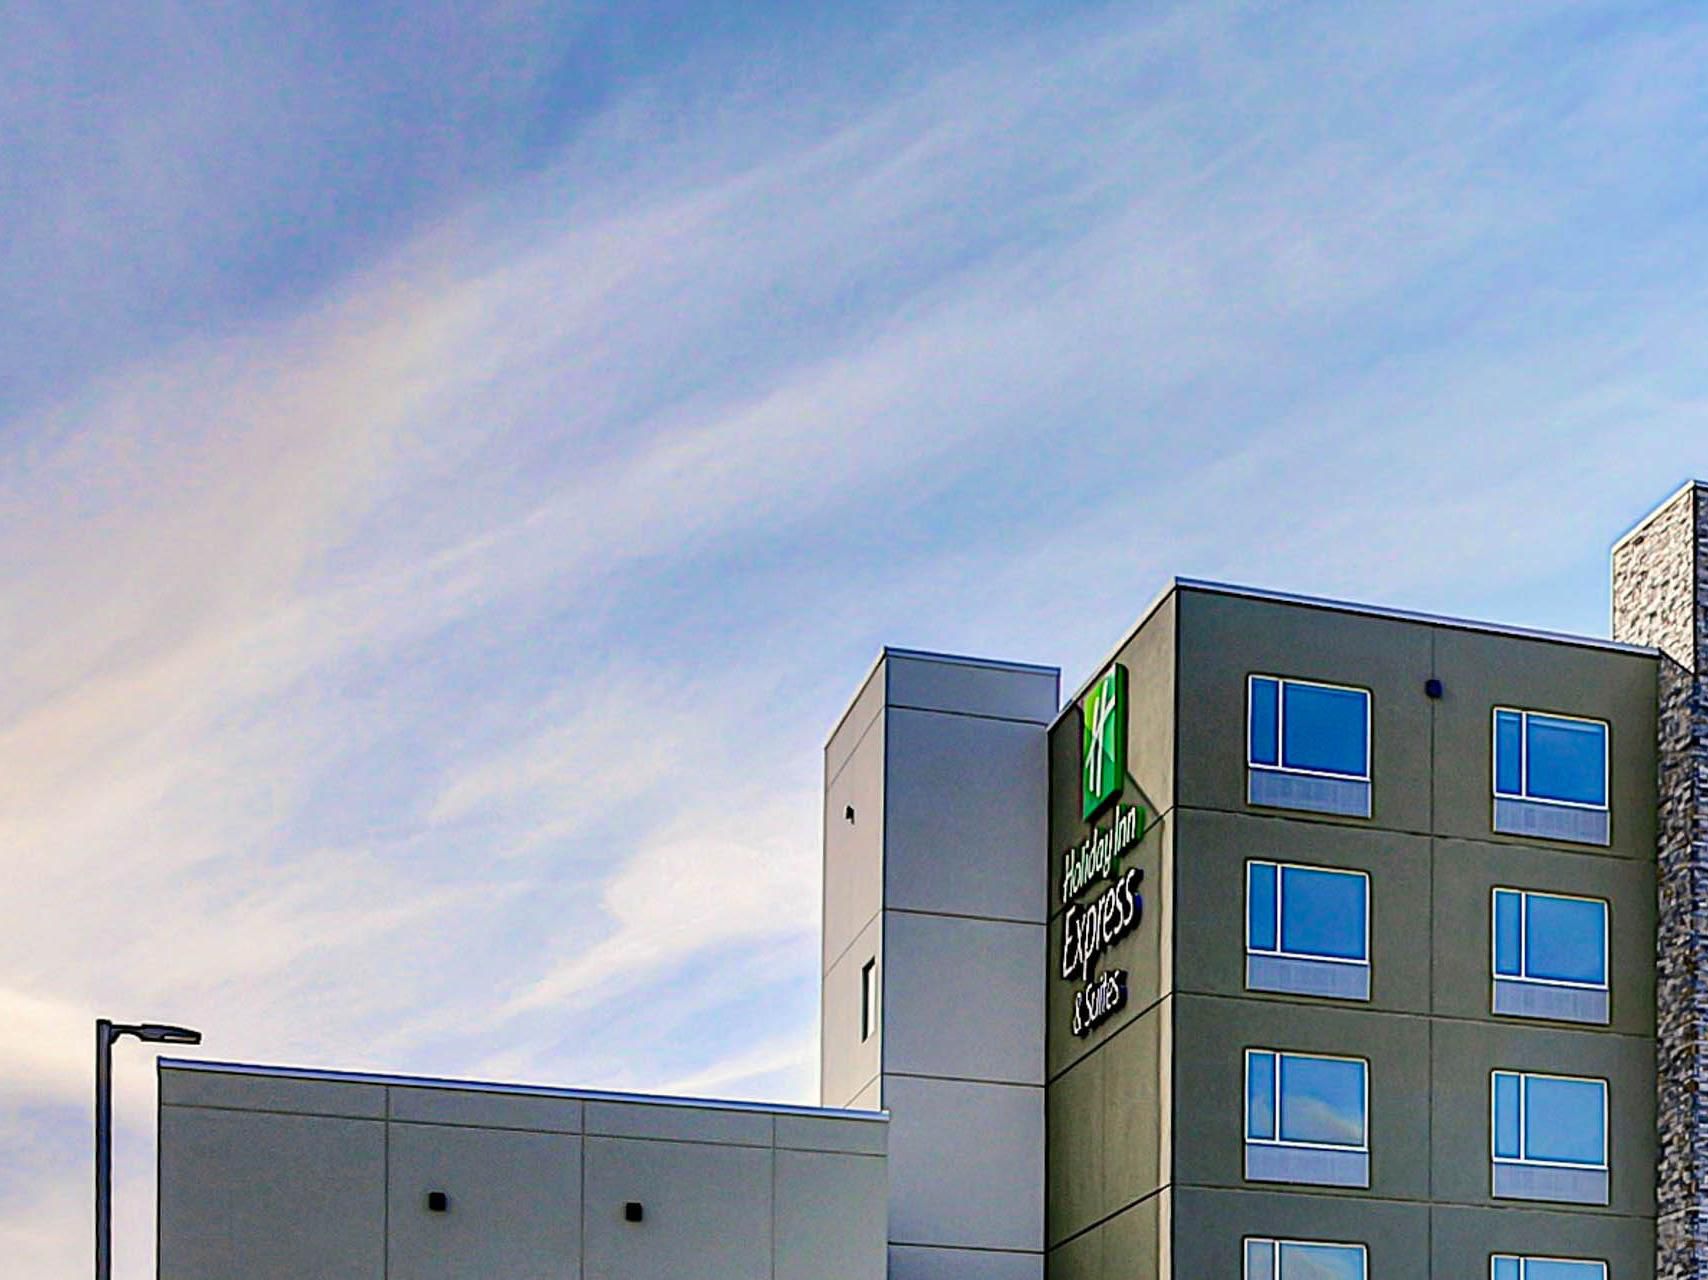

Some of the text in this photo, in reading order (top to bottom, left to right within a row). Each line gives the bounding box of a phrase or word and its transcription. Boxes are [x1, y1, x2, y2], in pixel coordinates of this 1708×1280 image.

[1063, 805, 1136, 904] Holiday Inn
[1063, 868, 1136, 981] Express
[1072, 970, 1119, 1034] & Suites
